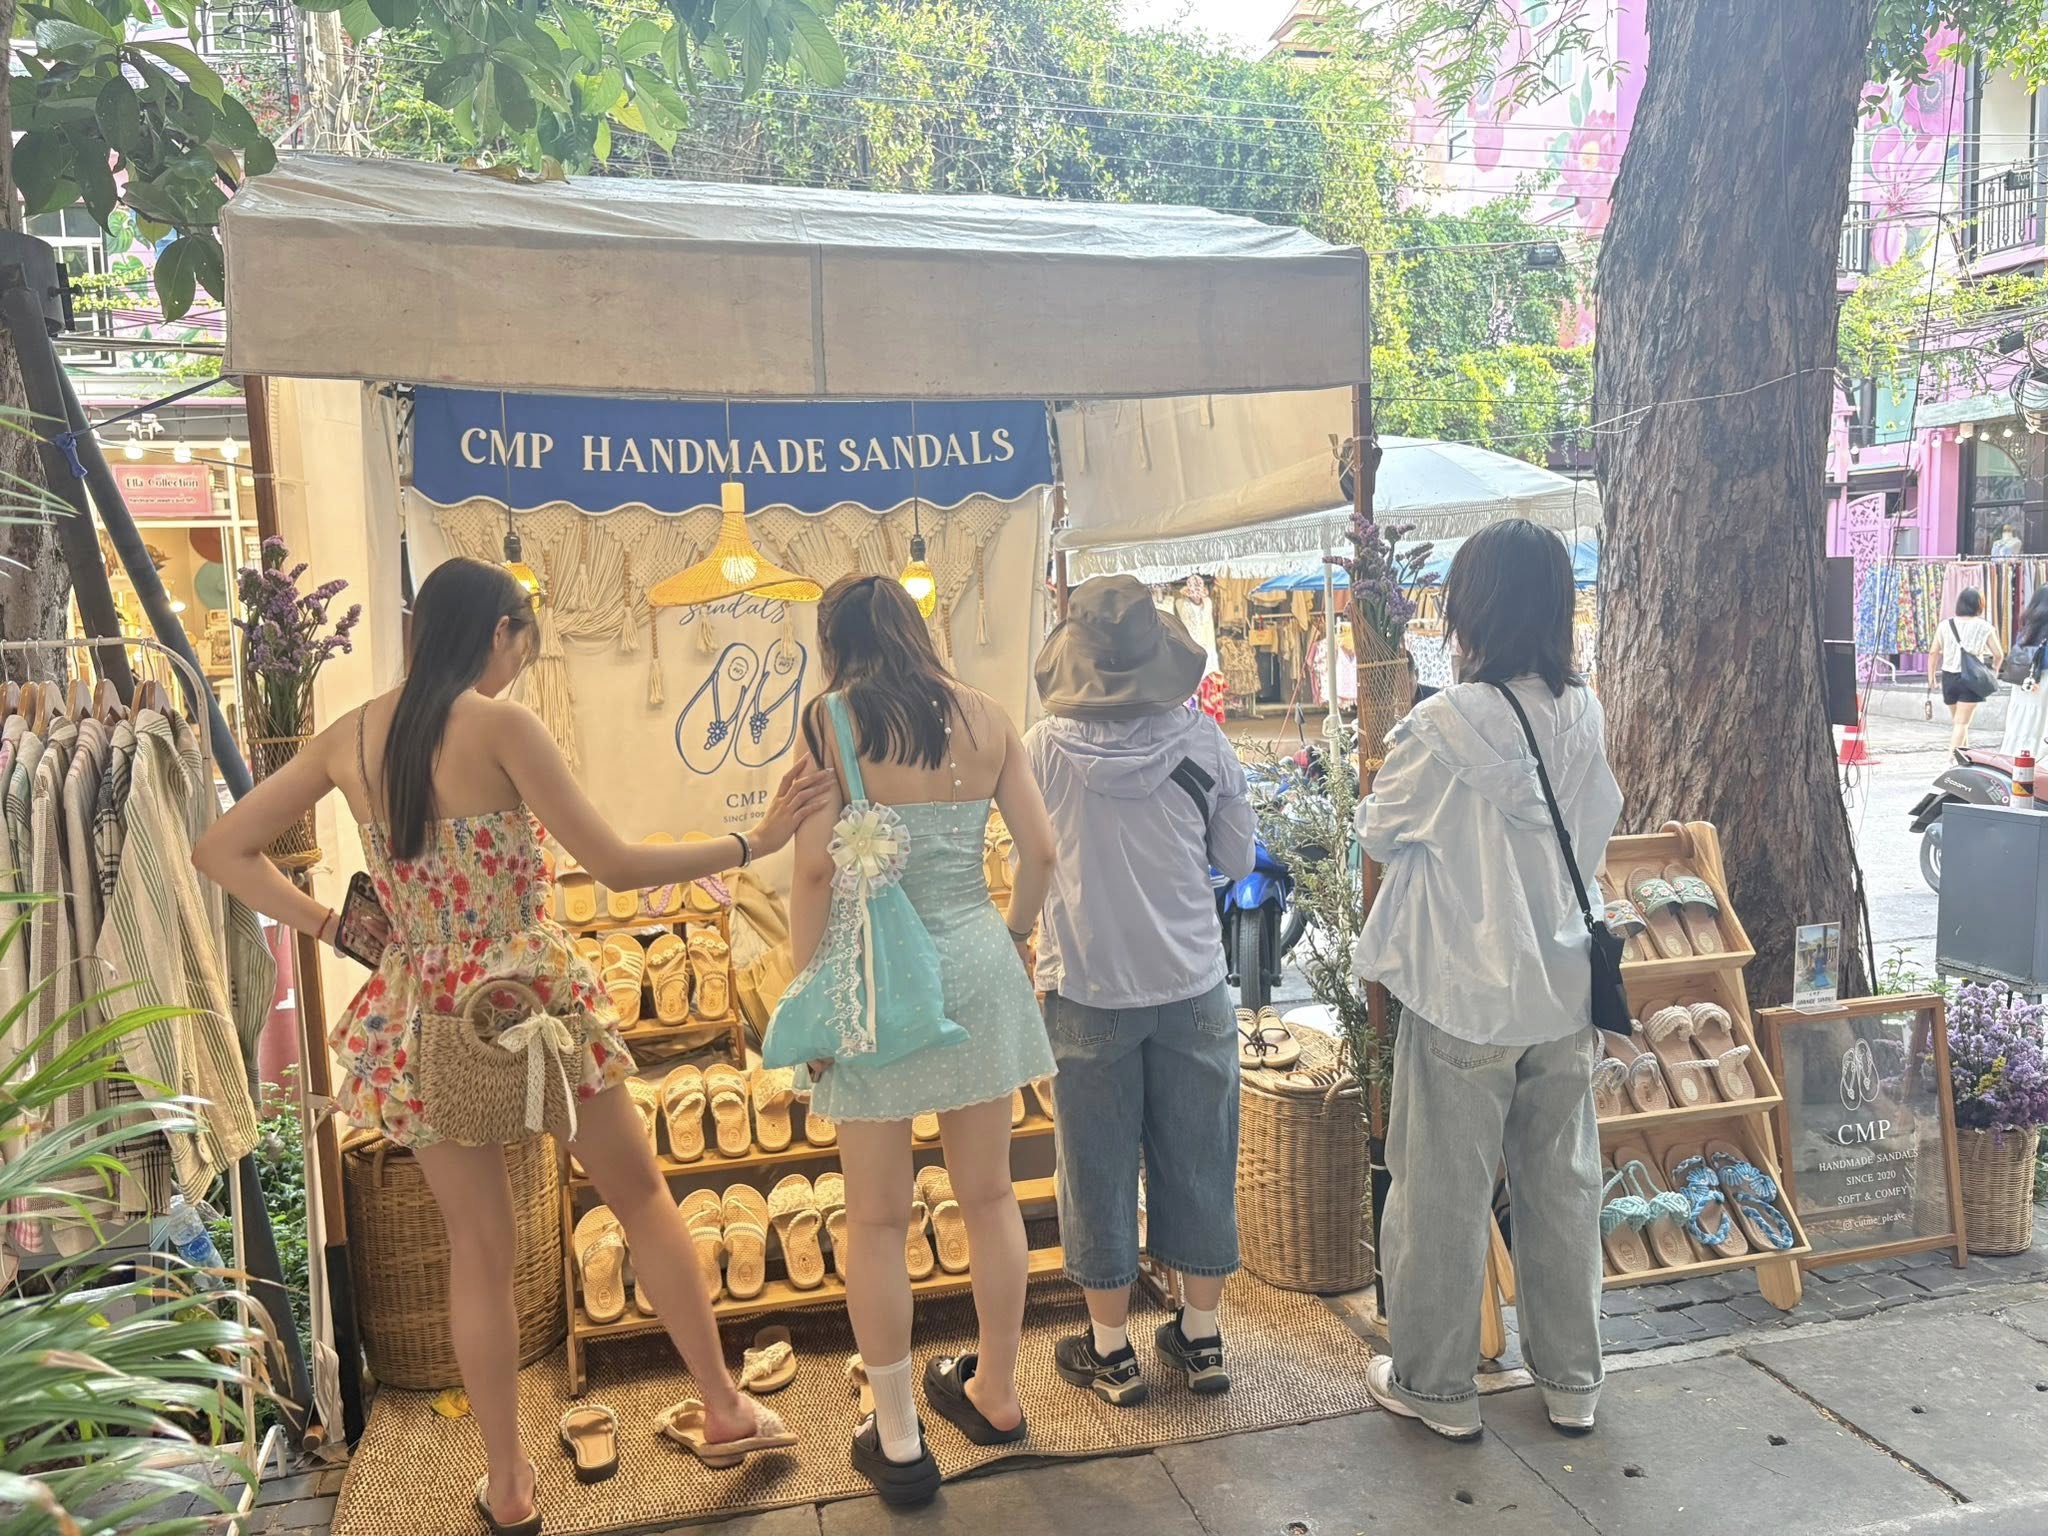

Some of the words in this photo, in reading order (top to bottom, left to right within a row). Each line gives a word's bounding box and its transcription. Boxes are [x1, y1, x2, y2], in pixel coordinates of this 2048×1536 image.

[460, 427, 554, 469] CMP
[581, 435, 827, 475] HANDMADE
[838, 428, 1015, 473] SANDALS
[726, 790, 768, 808] CMP
[723, 813, 748, 824] SINCE
[750, 811, 765, 819] 202
[1837, 1119, 1891, 1145] CMP
[1818, 1155, 1874, 1172] HANDMADE
[1876, 1149, 1919, 1163] SANDALS
[1846, 1173, 1874, 1186] SINCE
[1877, 1170, 1897, 1181] 2020
[1837, 1193, 1861, 1205] SOFT
[1864, 1192, 1872, 1201] &
[1874, 1185, 1908, 1199] COMFY
